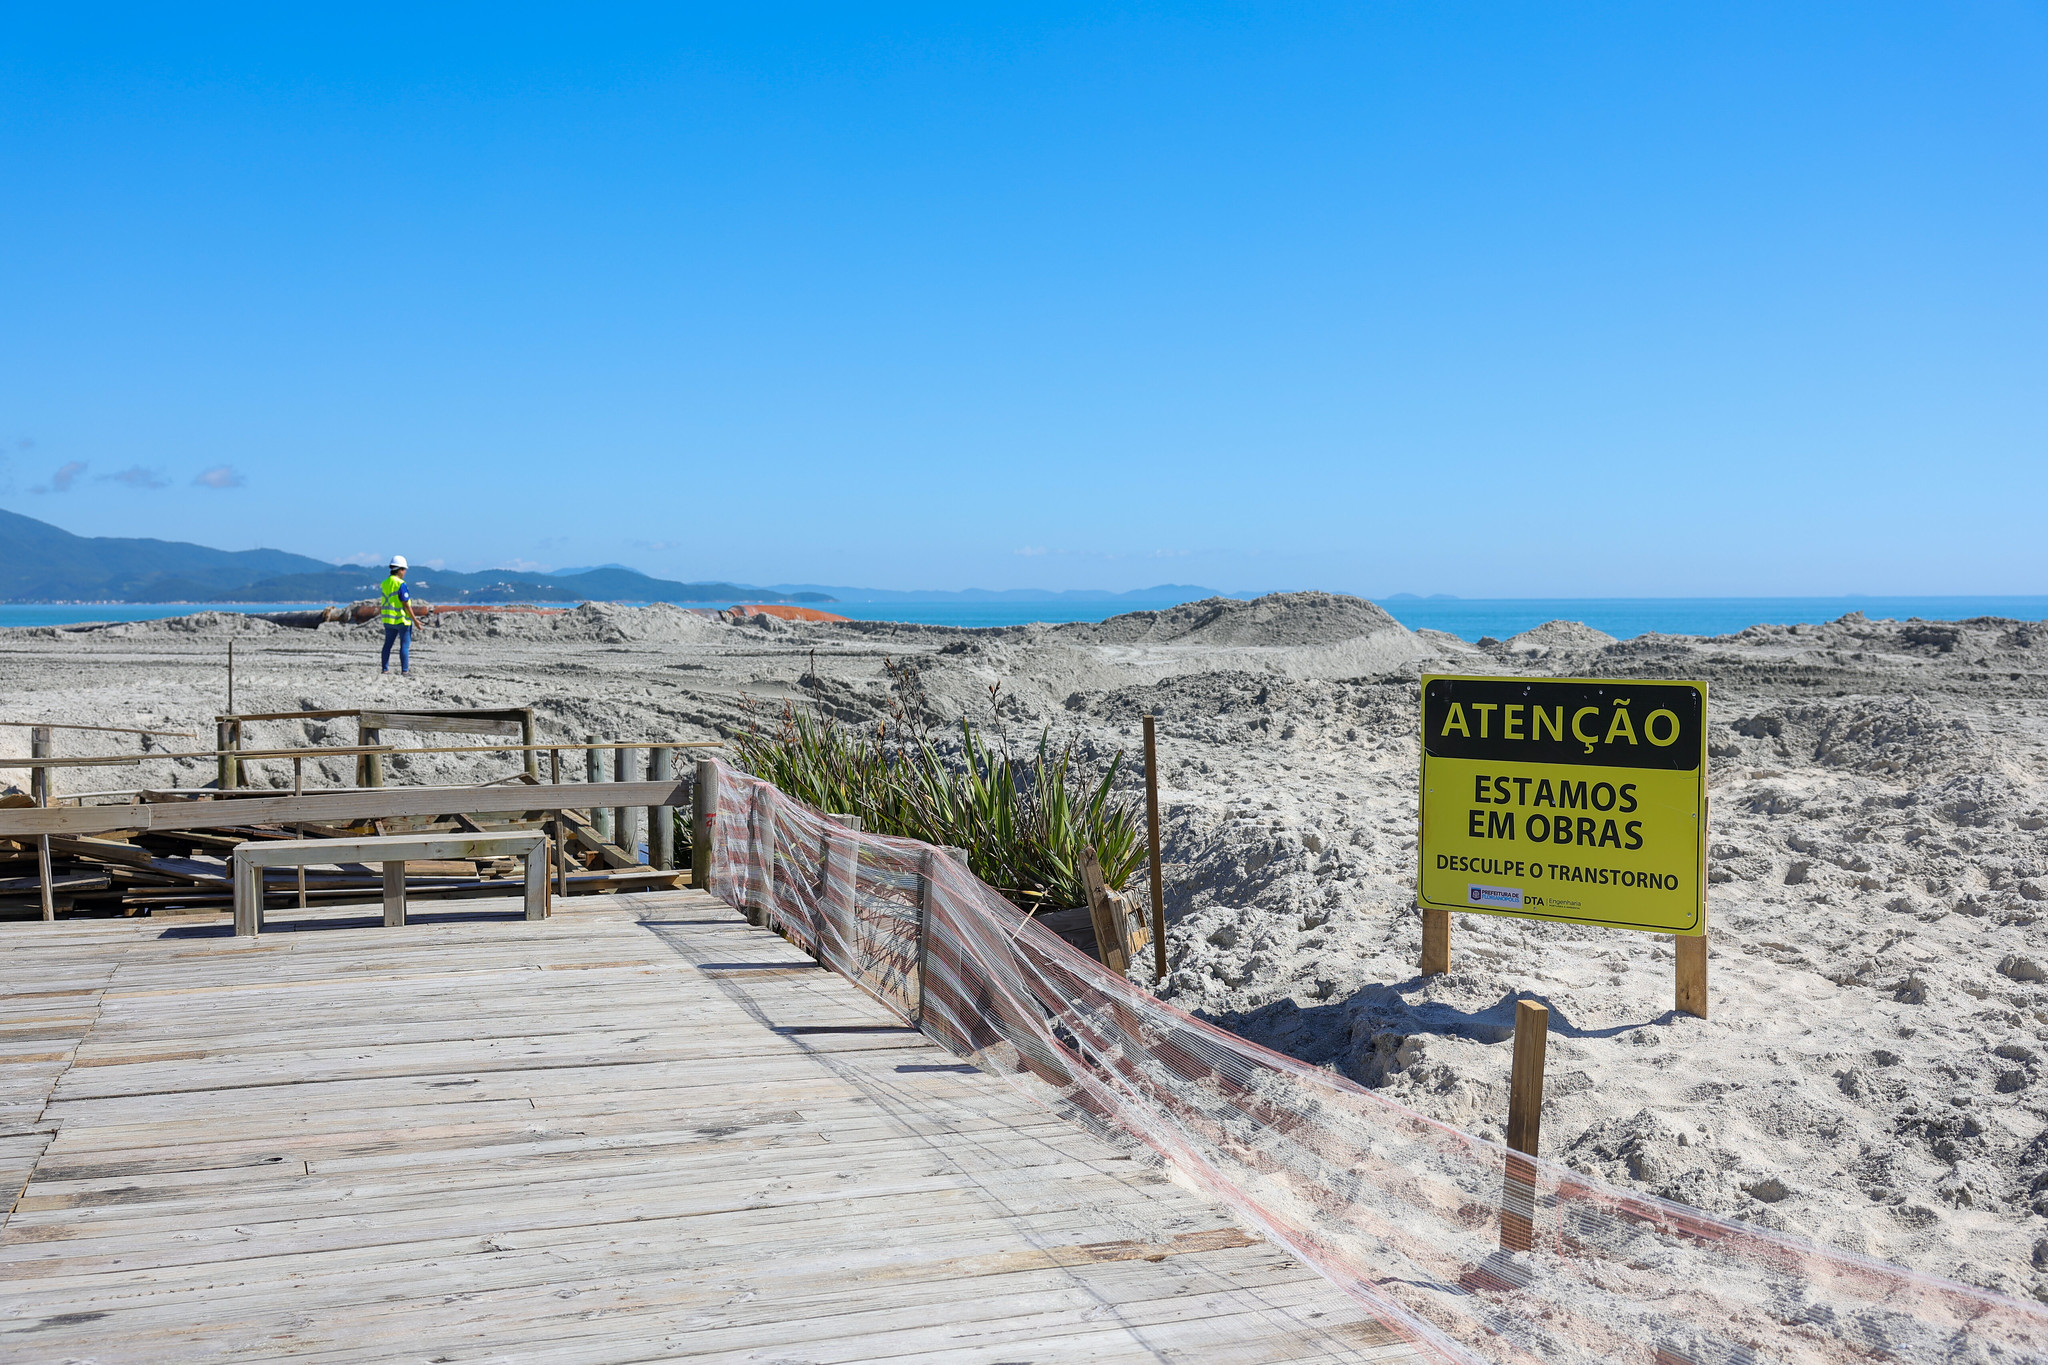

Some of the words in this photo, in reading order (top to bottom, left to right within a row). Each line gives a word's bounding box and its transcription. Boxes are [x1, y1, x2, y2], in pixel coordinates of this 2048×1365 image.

[1441, 698, 1681, 754] ATENÇÃO
[1475, 775, 1638, 813] ESTAMOS
[1469, 810, 1515, 840] EM
[1526, 813, 1643, 851] OBRAS
[1437, 854, 1524, 877] DESCULPE
[1529, 863, 1543, 878] O
[1548, 863, 1679, 891] TRANSTORNO
[1482, 889, 1511, 898] PREFEITURA
[1524, 896, 1544, 906] DTA
[1549, 898, 1581, 906] Engenharia
